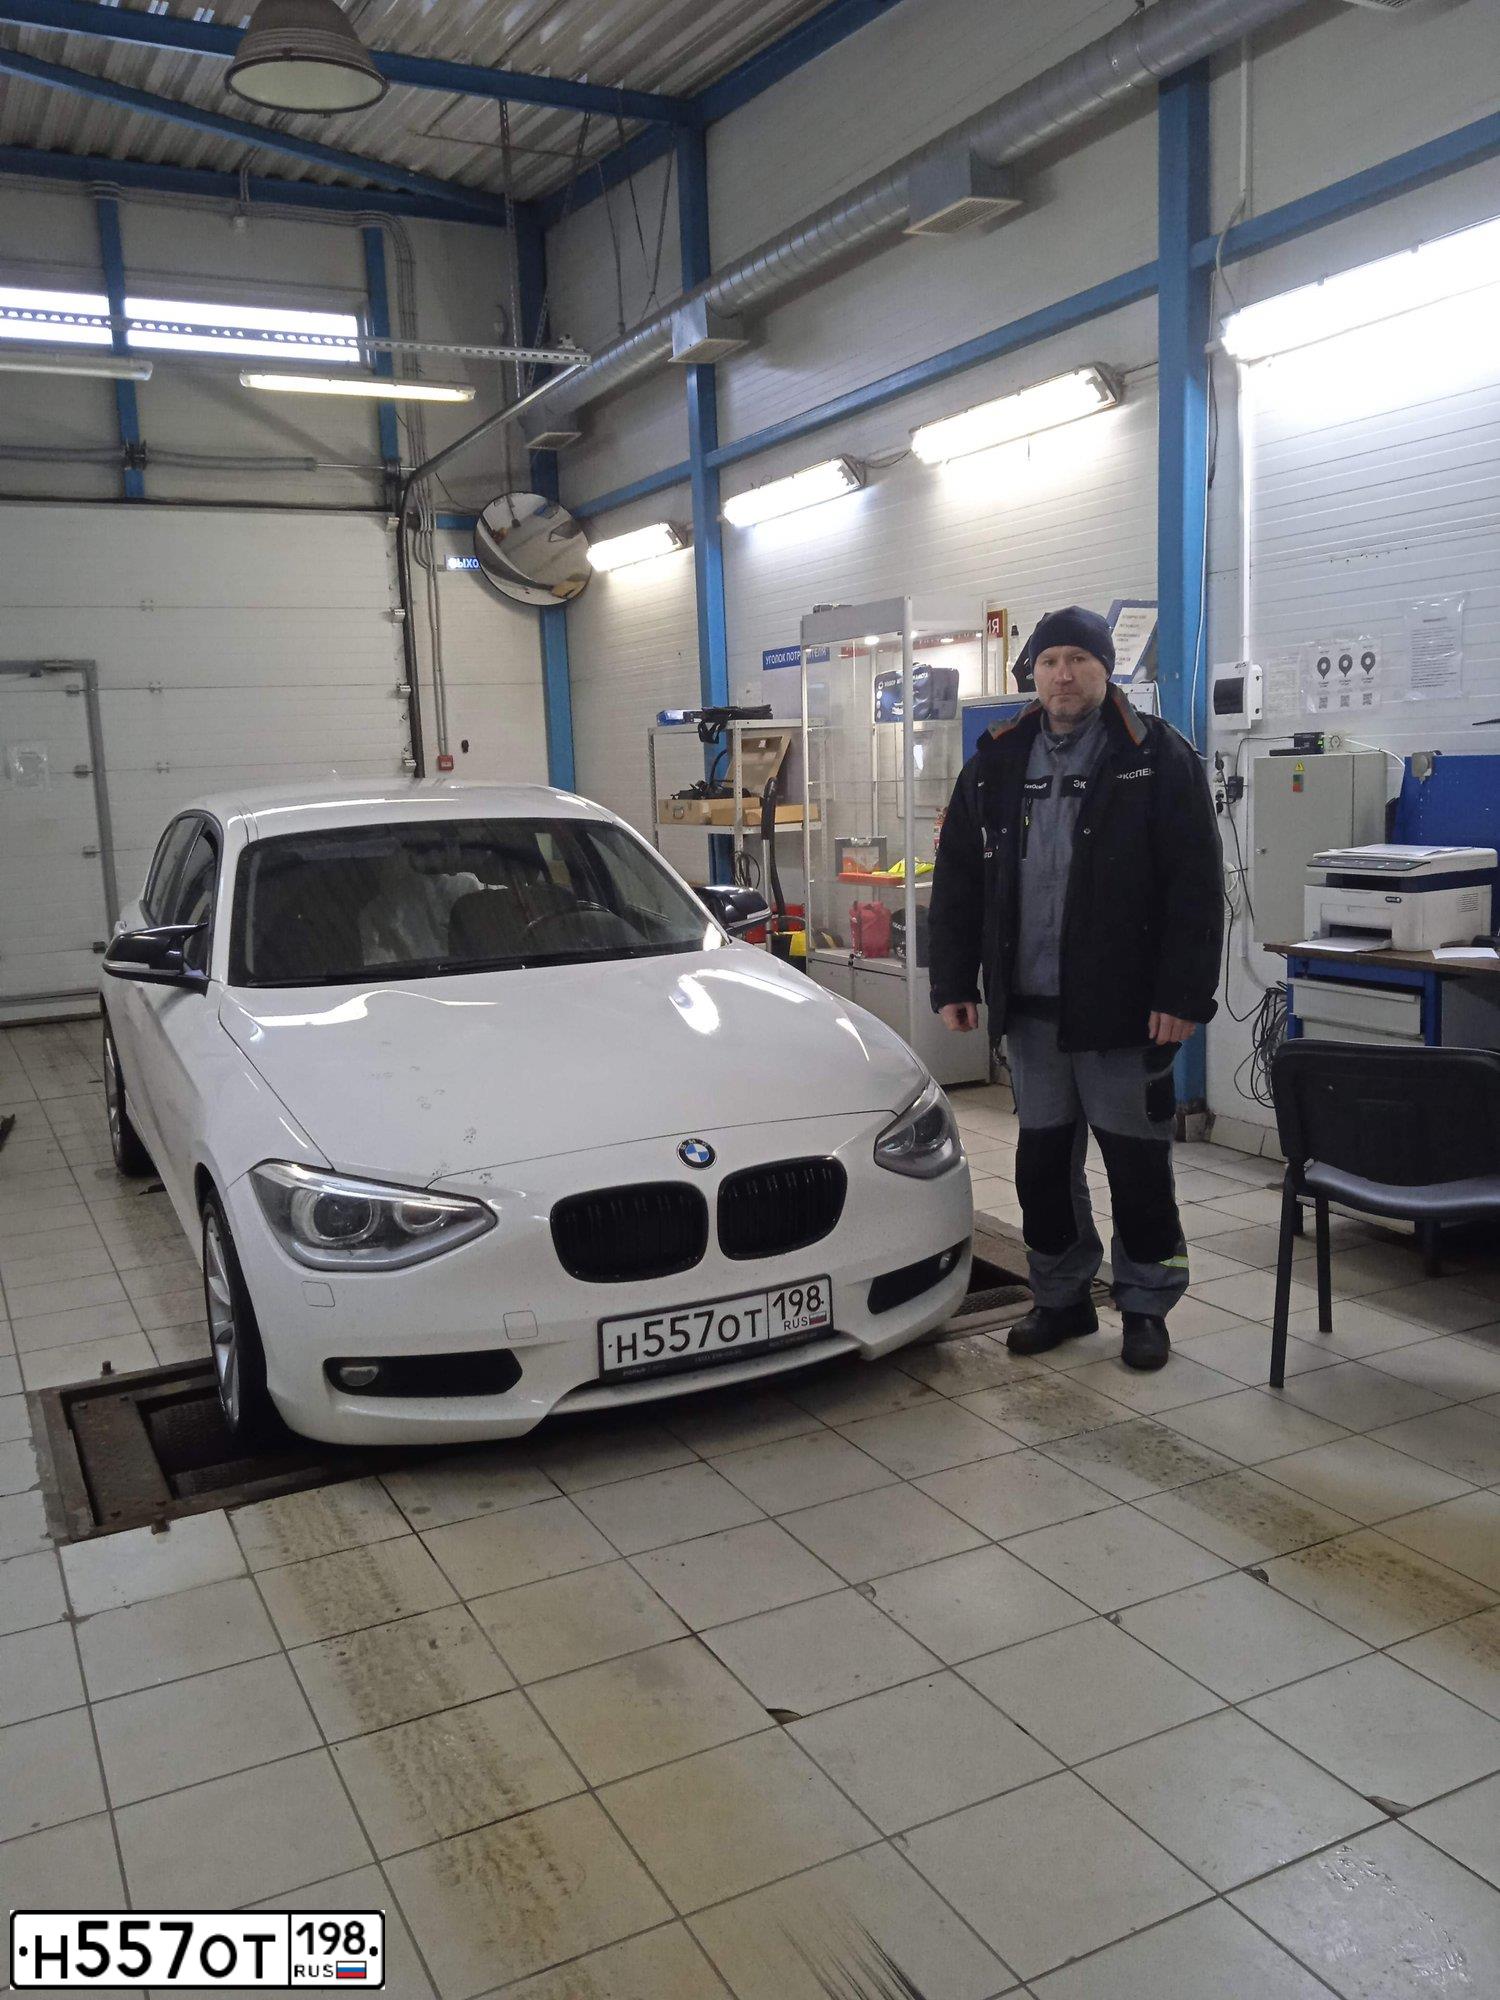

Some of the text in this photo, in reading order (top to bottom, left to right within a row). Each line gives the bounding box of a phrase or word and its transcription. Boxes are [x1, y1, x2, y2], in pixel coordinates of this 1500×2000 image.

[765, 652, 786, 665] УГОЛОК
[786, 647, 827, 662] ПОТРИТЕЛЯ
[772, 1284, 821, 1320] 198
[783, 1317, 808, 1331] RUS
